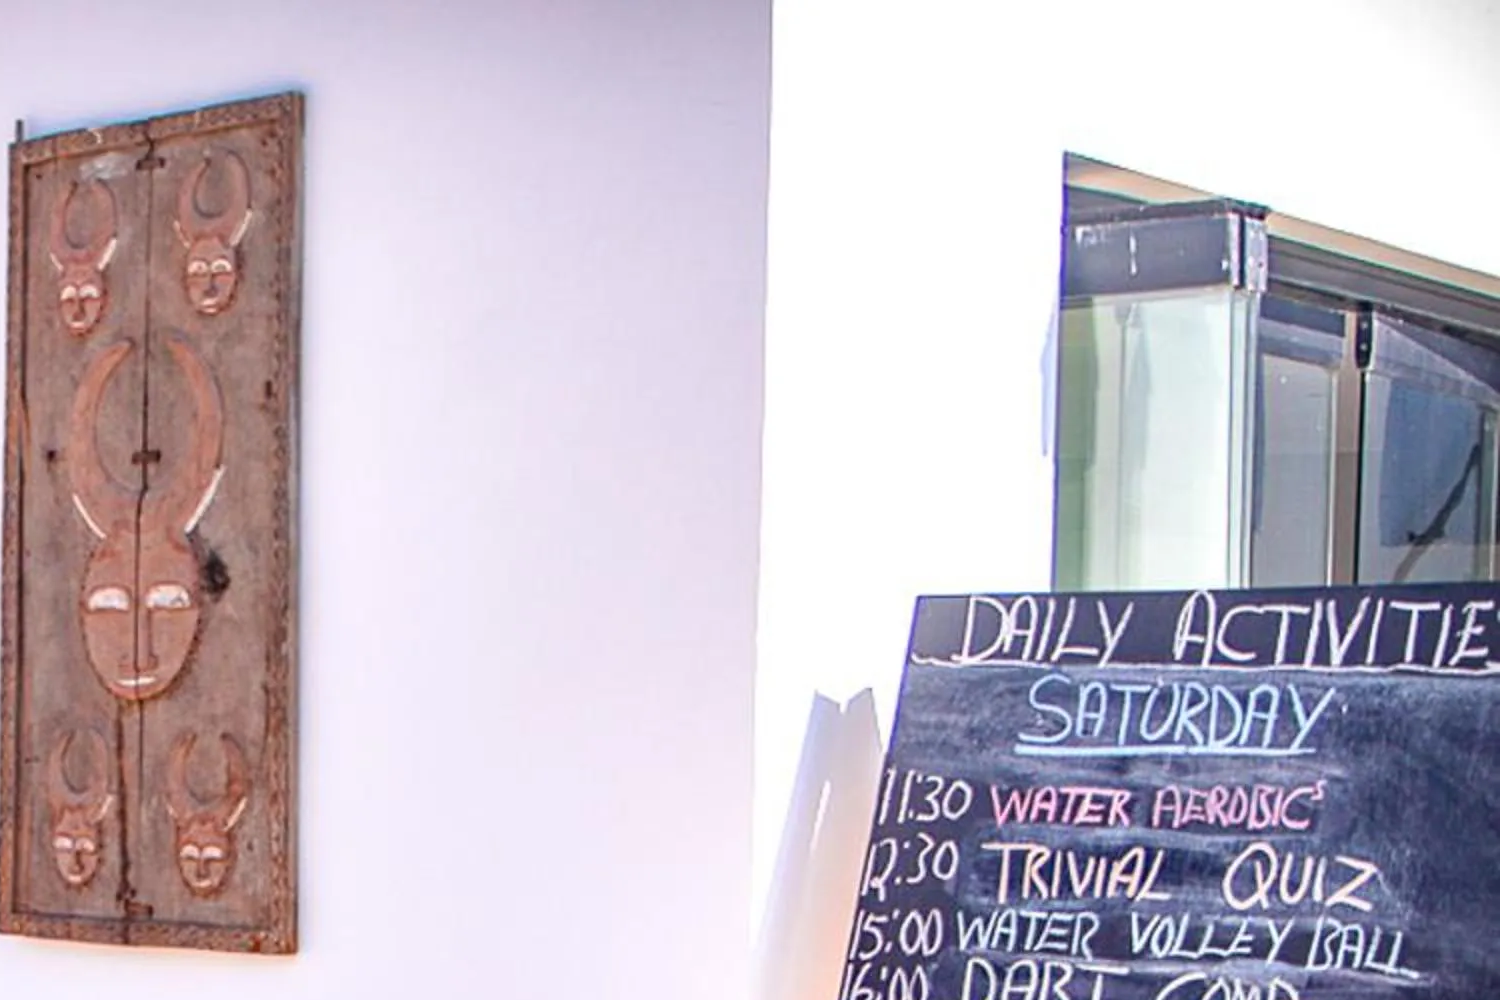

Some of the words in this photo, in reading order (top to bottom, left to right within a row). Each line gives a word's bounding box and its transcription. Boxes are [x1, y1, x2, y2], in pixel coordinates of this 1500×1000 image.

[951, 595, 1134, 668] DAILY
[1173, 588, 1500, 670] ACTIVITIE
[1018, 674, 1336, 746] SATURDAY
[878, 766, 973, 825] 11:30
[990, 784, 1133, 829] WATER
[980, 840, 1173, 905] TRIVIAL
[1221, 841, 1382, 911] QUIZ
[849, 907, 944, 962] 15:00
[956, 910, 1100, 960] WATER
[1129, 913, 1293, 963] VOLLEY
[1304, 913, 1420, 980] BALL
